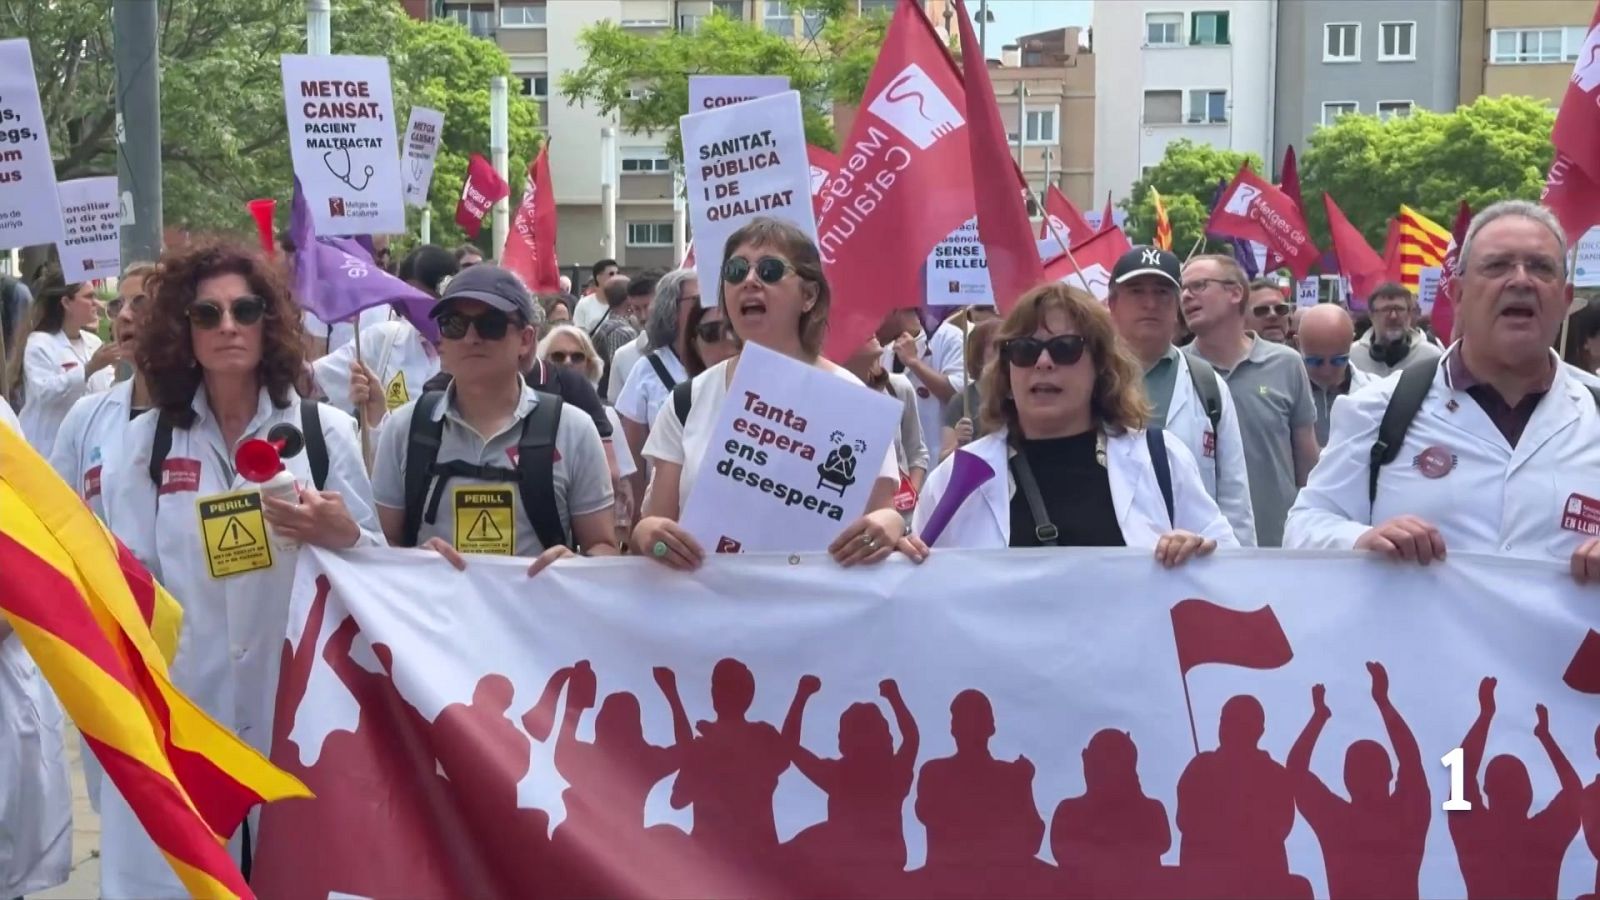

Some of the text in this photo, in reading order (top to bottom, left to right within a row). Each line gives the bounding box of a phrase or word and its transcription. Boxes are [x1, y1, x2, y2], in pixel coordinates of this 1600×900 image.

[301, 81, 370, 97] METGE
[703, 96, 758, 109] CON
[303, 103, 383, 121] CANSAT,
[305, 123, 356, 133] PACIENT
[306, 138, 383, 149] MALTRACTAT
[700, 130, 776, 160] SANITAT,
[702, 151, 780, 181] PÚBLICA
[704, 181, 740, 201] I DE
[65, 203, 110, 213] onciliar
[707, 190, 793, 221] QUALITAT
[936, 246, 980, 256] SENSE
[936, 259, 987, 268] RELLEU
[744, 391, 808, 433] Tanta
[733, 417, 816, 461] espera
[724, 438, 768, 467] ens
[716, 458, 844, 522] desespera
[209, 498, 252, 514] PERILL
[464, 494, 504, 504] PERILL
